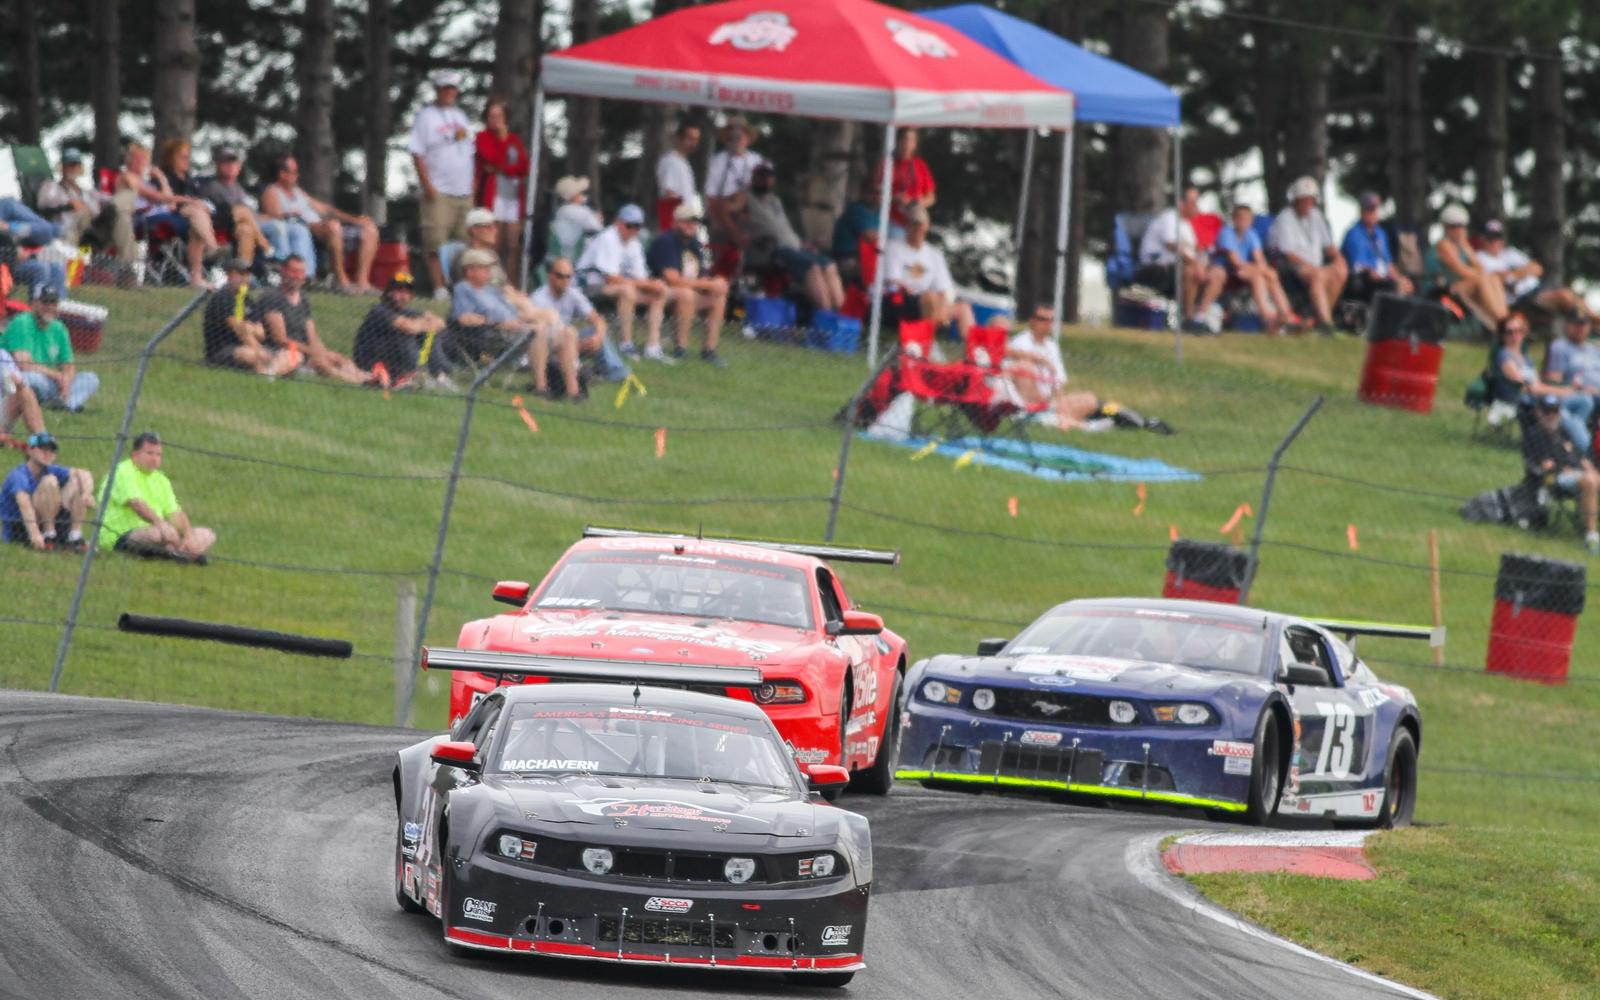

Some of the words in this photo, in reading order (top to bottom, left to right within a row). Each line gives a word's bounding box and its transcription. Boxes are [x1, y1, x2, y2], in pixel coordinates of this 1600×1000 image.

[533, 711, 604, 720] AMERICA'S
[651, 714, 704, 728] RACING
[707, 722, 750, 735] SERIES
[1314, 702, 1355, 779] 73
[502, 759, 600, 771] MACHAVERN
